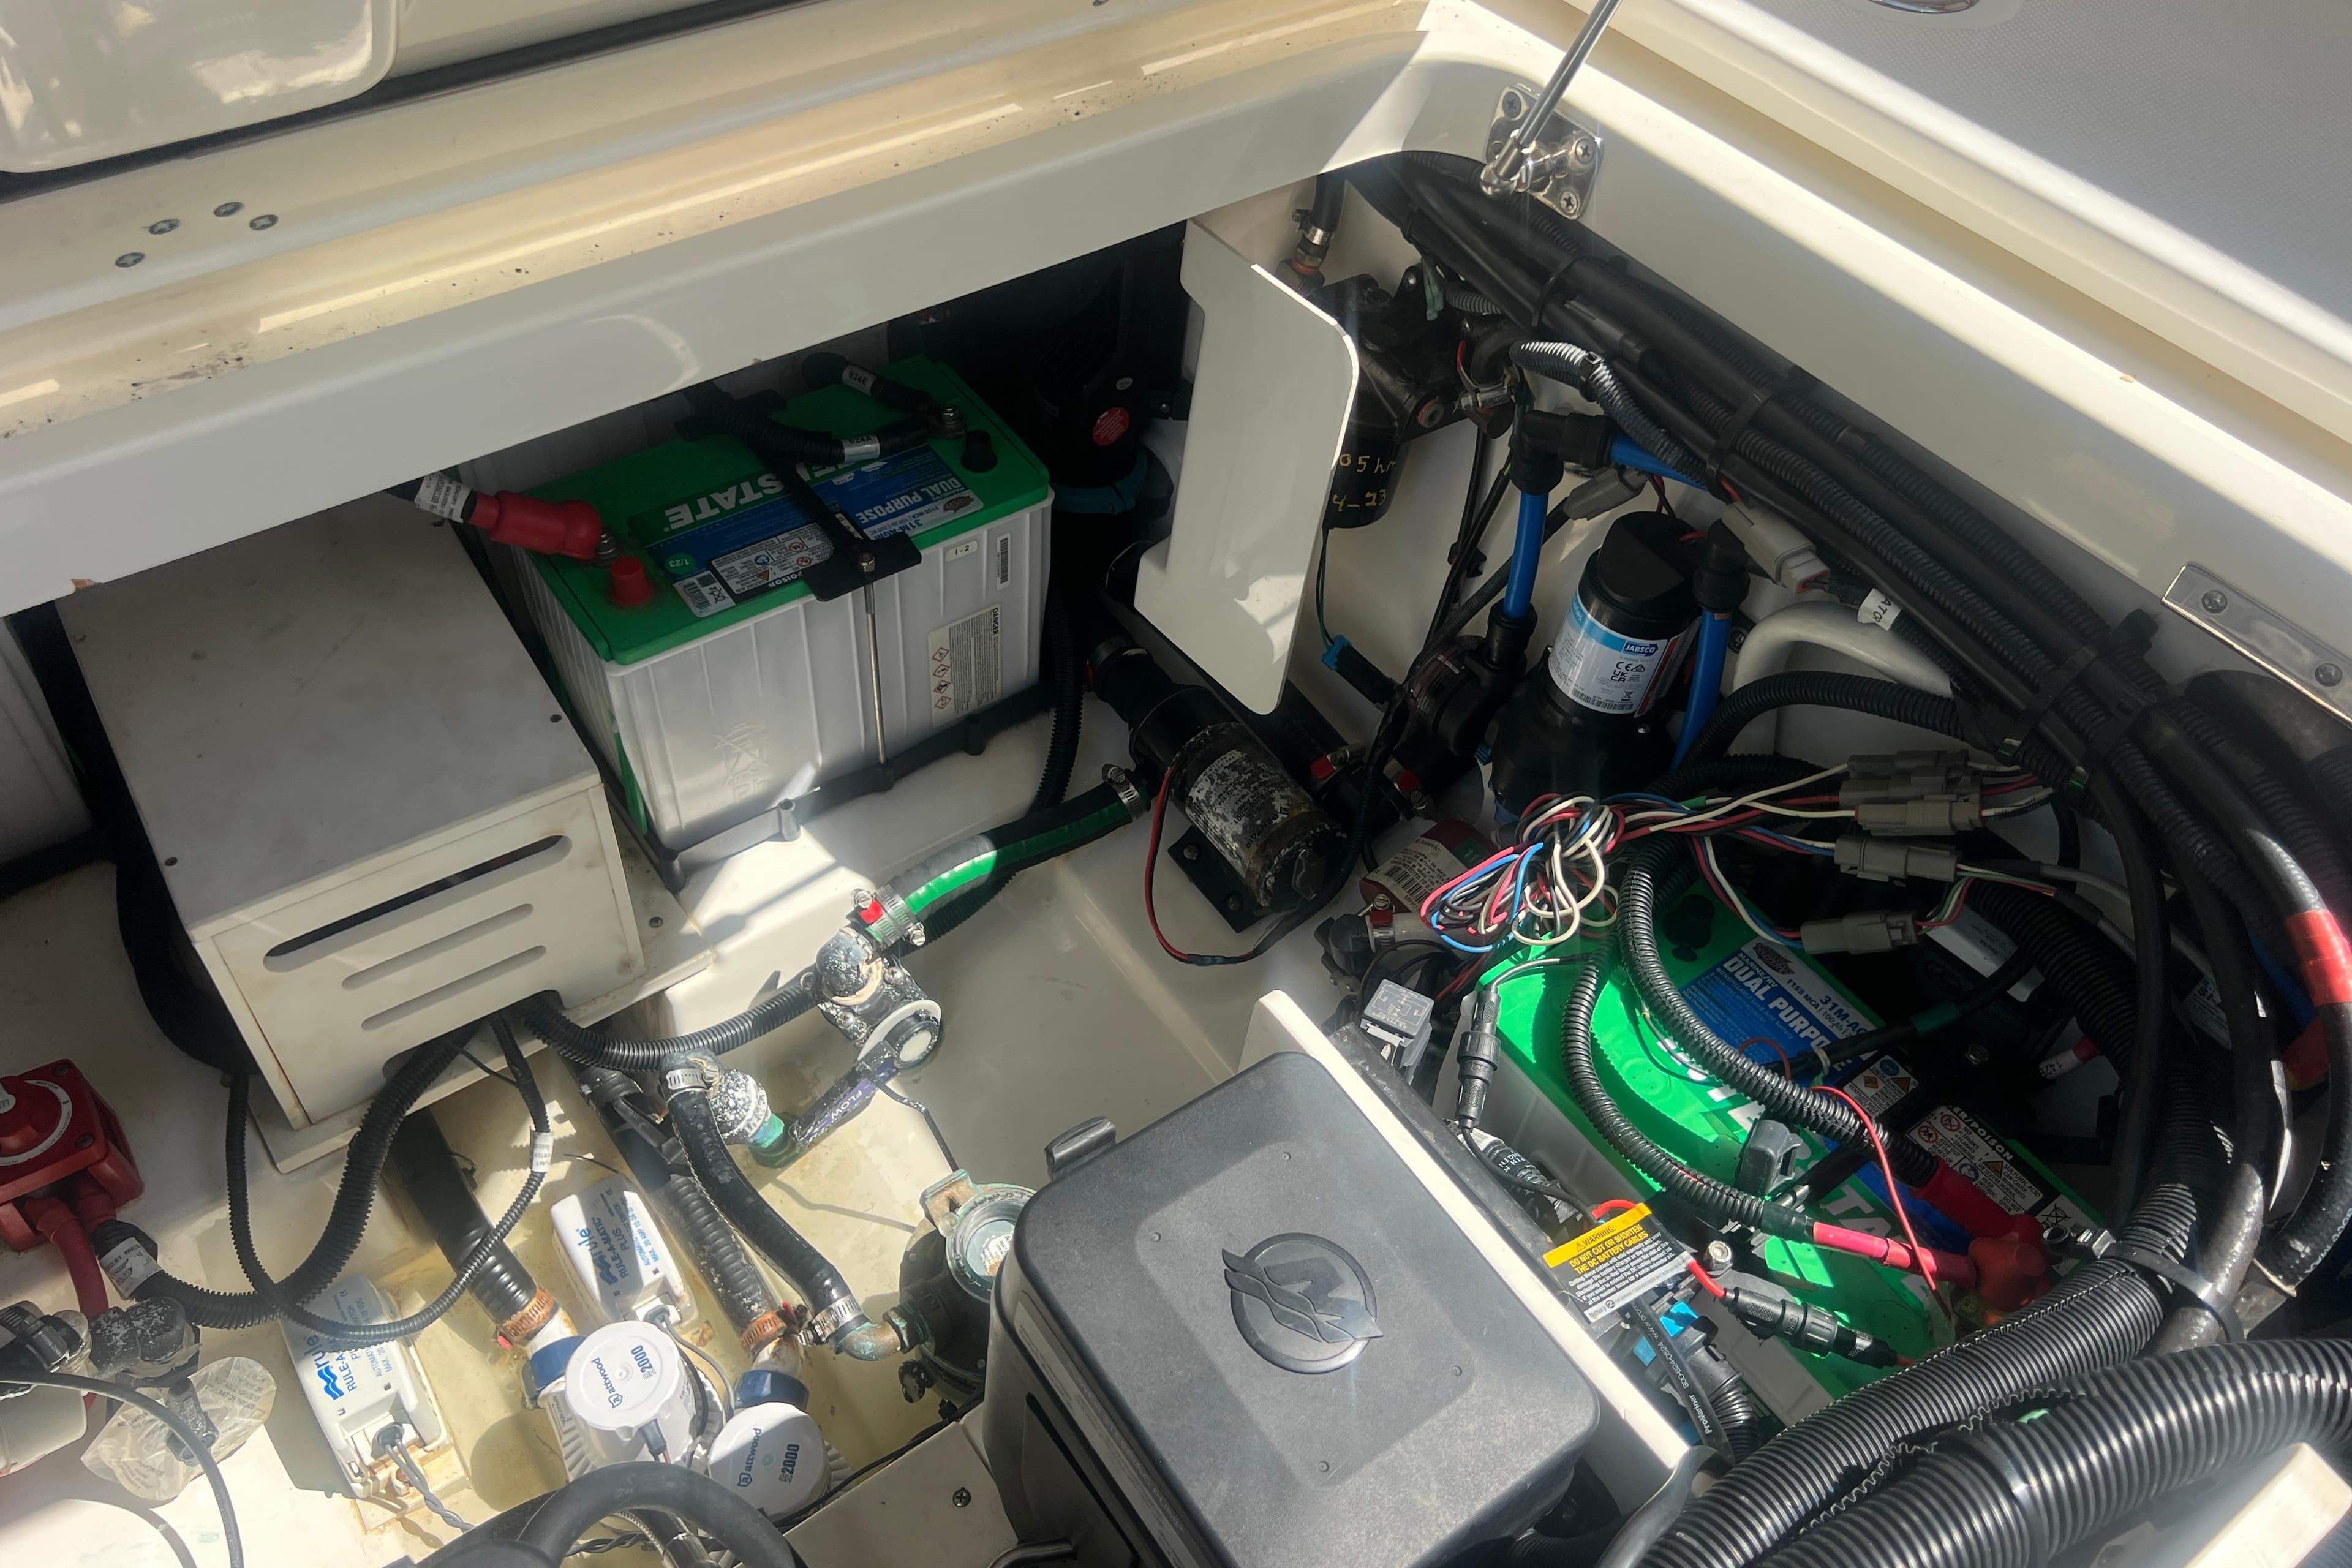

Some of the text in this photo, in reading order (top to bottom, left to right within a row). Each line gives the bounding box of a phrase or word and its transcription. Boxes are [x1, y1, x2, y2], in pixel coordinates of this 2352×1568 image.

[854, 475, 962, 525] DUAL PURPOSE
[669, 559, 690, 568] 1/23
[1624, 644, 1656, 654] JABSCO
[1722, 952, 1773, 1001] DUAL
[1737, 952, 1778, 989] MARINE/RV
[1786, 978, 1804, 996] 1155
[1803, 993, 1820, 1009] MCA
[1819, 993, 1867, 1038] 31M-AG
[831, 1090, 863, 1123] FLOW
[2000, 1176, 2026, 1199] BLINDNESS
[2003, 1164, 2041, 1197] SULFURIC ACID
[2011, 1178, 2027, 1193] CAUSE
[578, 1228, 603, 1258] rule
[592, 1217, 629, 1278] RULE-A-MATIC
[612, 1229, 629, 1251] PLUS
[1569, 1223, 1643, 1268] DO NOT CUT OR SHORTEN
[1575, 1229, 1649, 1275] THE DC BATTERY CABLES
[1582, 1224, 1616, 1247] WARNING:
[304, 1335, 330, 1369] rule
[631, 1345, 654, 1374] 2000
[590, 1357, 617, 1395] attwood
[1688, 1393, 1714, 1435] ProMariner
[744, 1428, 763, 1473] attwood
[781, 1444, 801, 1476] 2000
